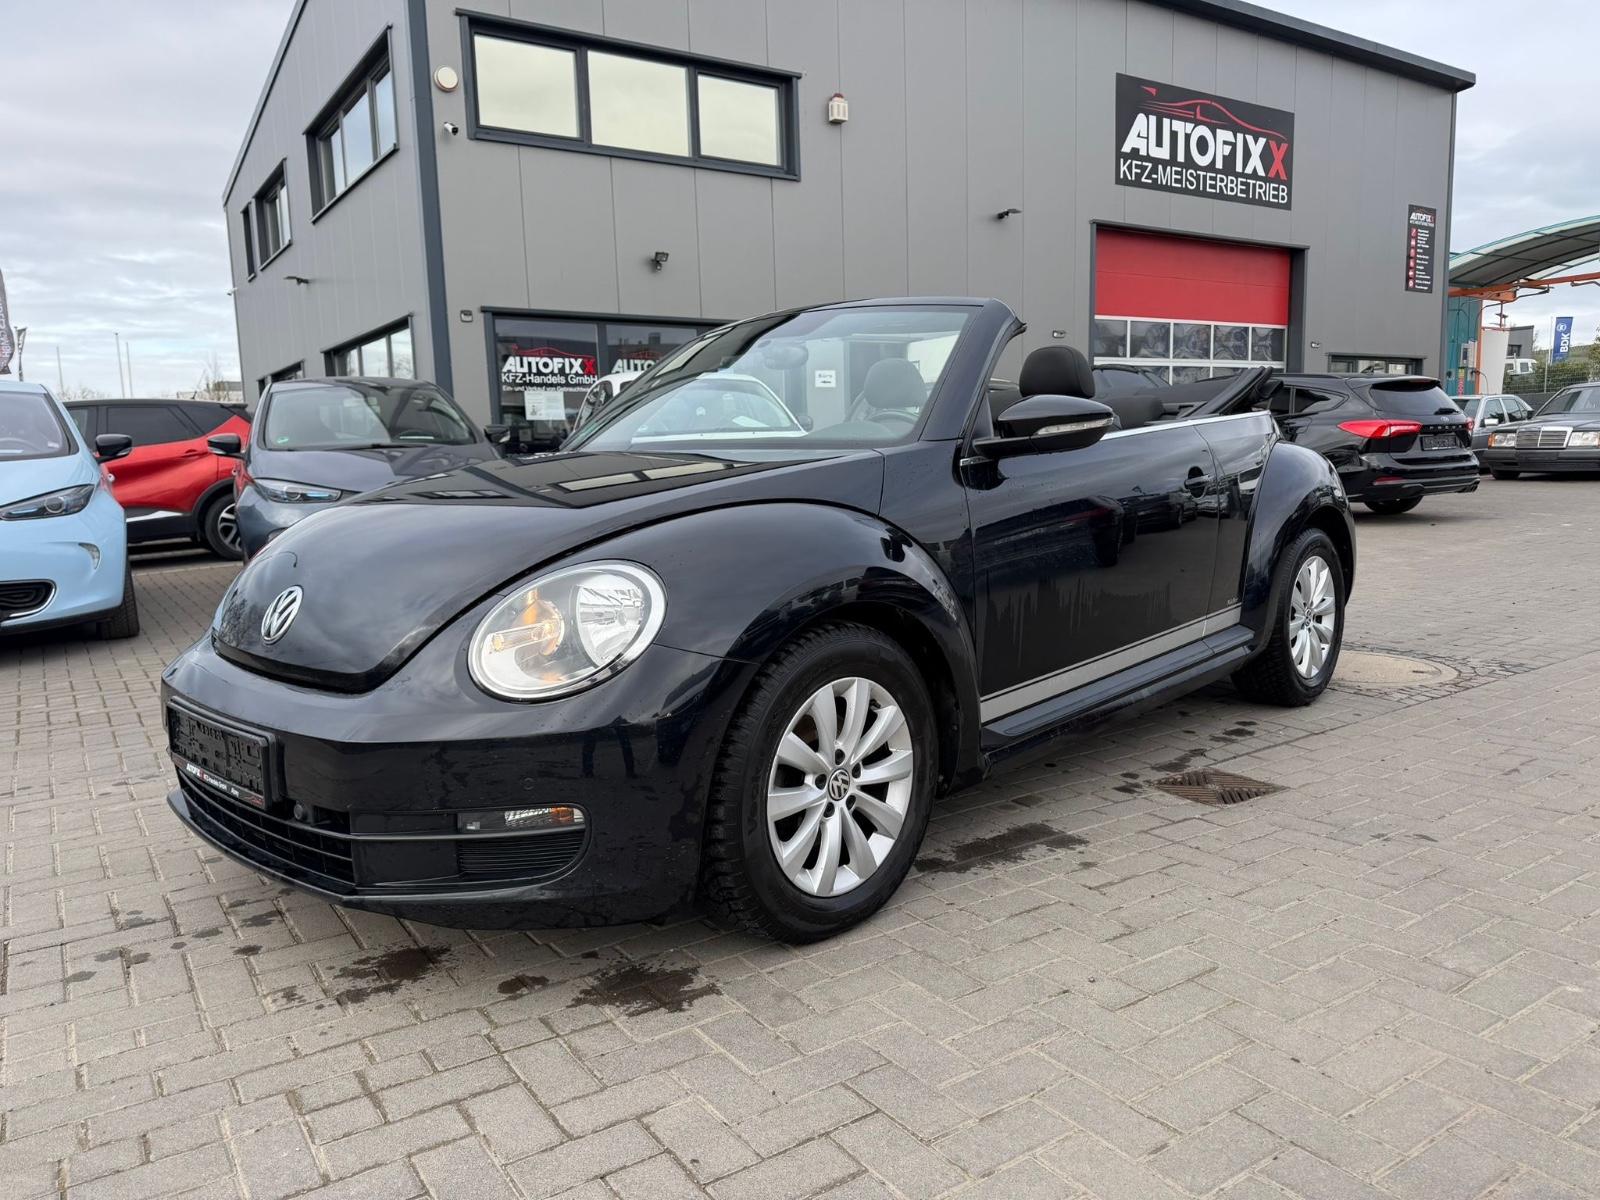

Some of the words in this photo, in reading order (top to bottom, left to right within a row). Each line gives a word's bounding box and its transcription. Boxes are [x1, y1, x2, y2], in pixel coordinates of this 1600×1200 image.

[1121, 113, 1288, 180] AUTOFIXX
[1120, 158, 1288, 204] KFZ-MEISTERBETRIEB
[1560, 333, 1570, 352] BDK
[502, 356, 596, 376] AUTOFIXX
[502, 373, 566, 384] KFZ-Handels
[567, 374, 598, 384] GmbH
